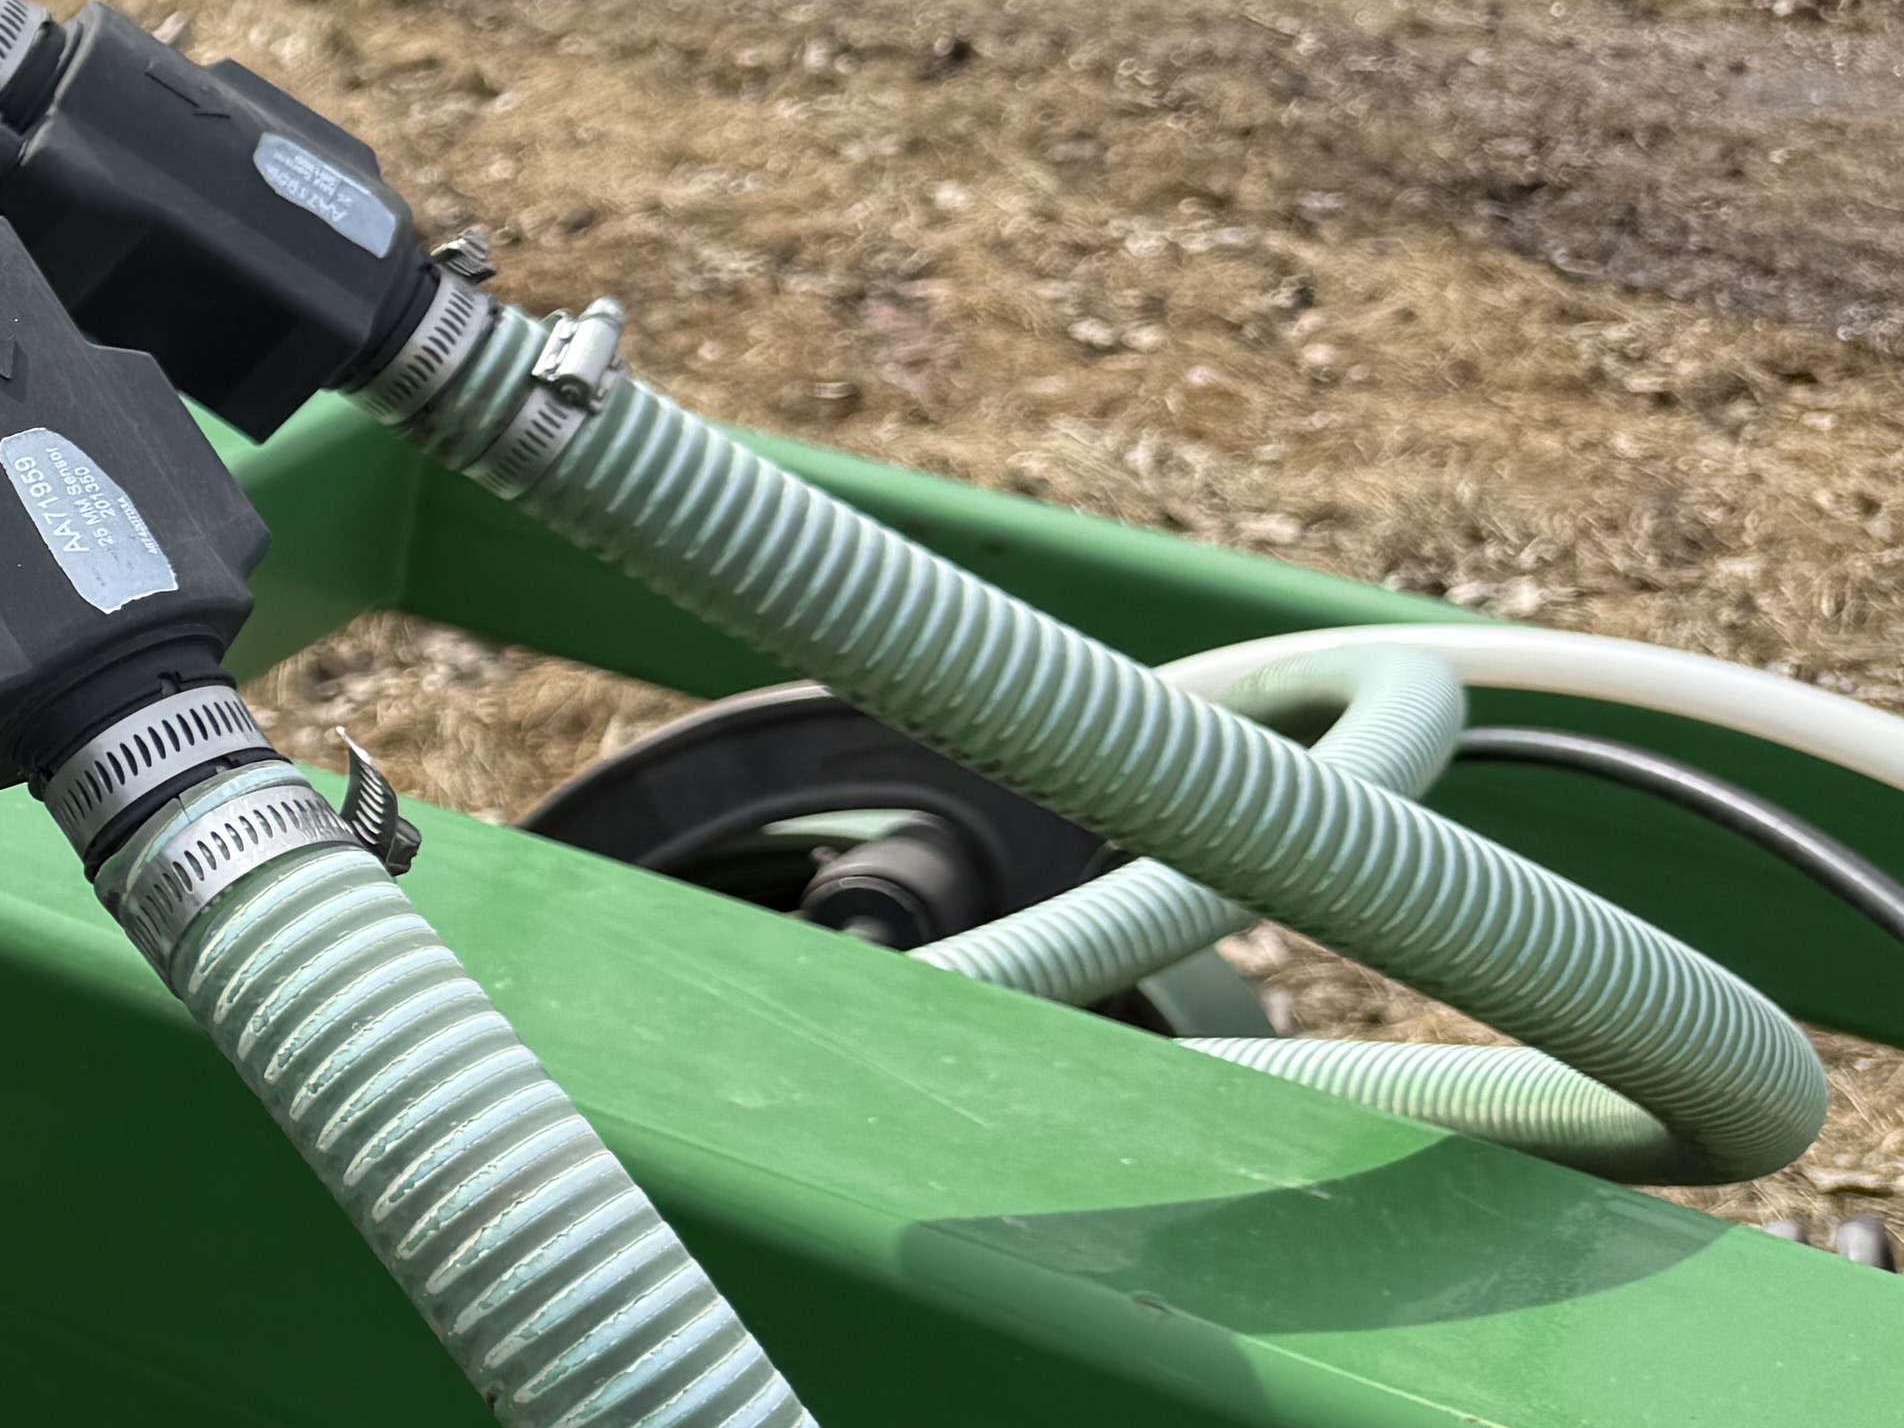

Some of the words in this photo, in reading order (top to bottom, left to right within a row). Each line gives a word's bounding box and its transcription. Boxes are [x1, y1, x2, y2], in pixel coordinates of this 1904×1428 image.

[45, 446, 83, 496] Sensor
[74, 467, 116, 519] 201350
[14, 456, 90, 553] AA71959
[74, 497, 102, 526] MM
